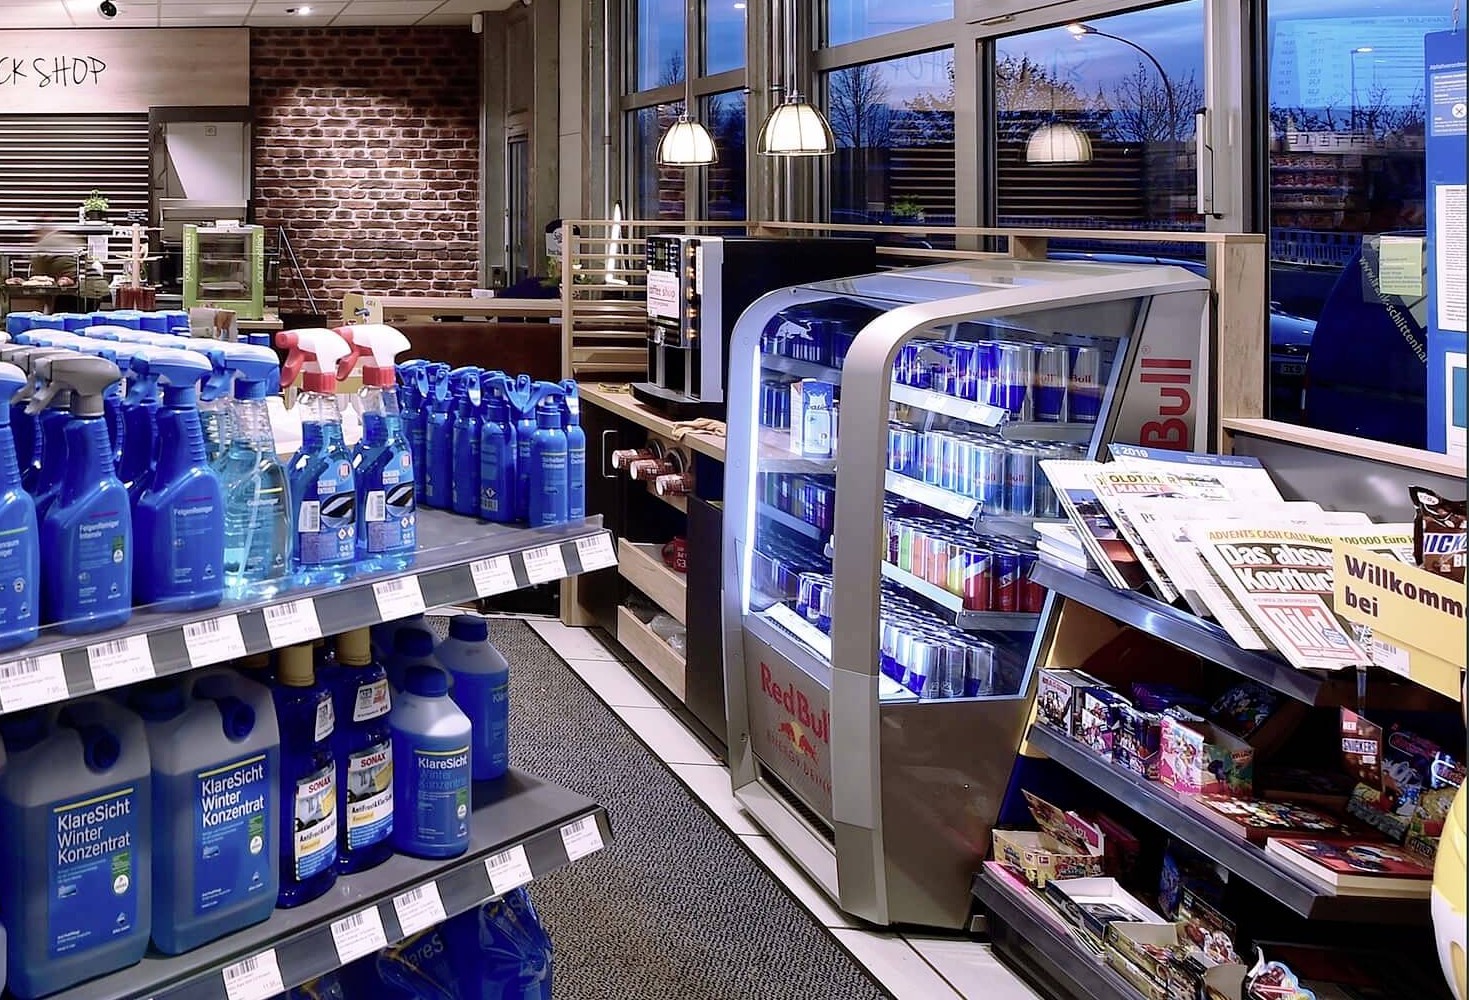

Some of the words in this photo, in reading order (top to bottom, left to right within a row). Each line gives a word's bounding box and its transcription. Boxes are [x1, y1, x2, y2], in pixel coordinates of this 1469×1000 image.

[32, 55, 107, 88] SHOP
[1139, 358, 1192, 450] Bull
[1123, 446, 1149, 458] 2019
[1109, 474, 1177, 485] OLDTIMR
[1209, 530, 1256, 541] ADVENTS
[1256, 530, 1282, 540] CASH
[1382, 535, 1407, 545] Euro
[1222, 545, 1269, 566] Das
[1344, 553, 1464, 619] Willkomm
[1345, 585, 1379, 618] bei
[760, 661, 795, 716] Red
[359, 751, 387, 769] SONAX
[417, 755, 469, 770] KlareSicht
[201, 763, 264, 797] KlareSicht
[307, 776, 332, 793] SONAX
[57, 798, 131, 833] KlareSicht
[201, 790, 242, 813] Winter
[201, 795, 265, 829] Konzentrat
[57, 826, 104, 849] Winter
[57, 831, 131, 866] Konzentrat
